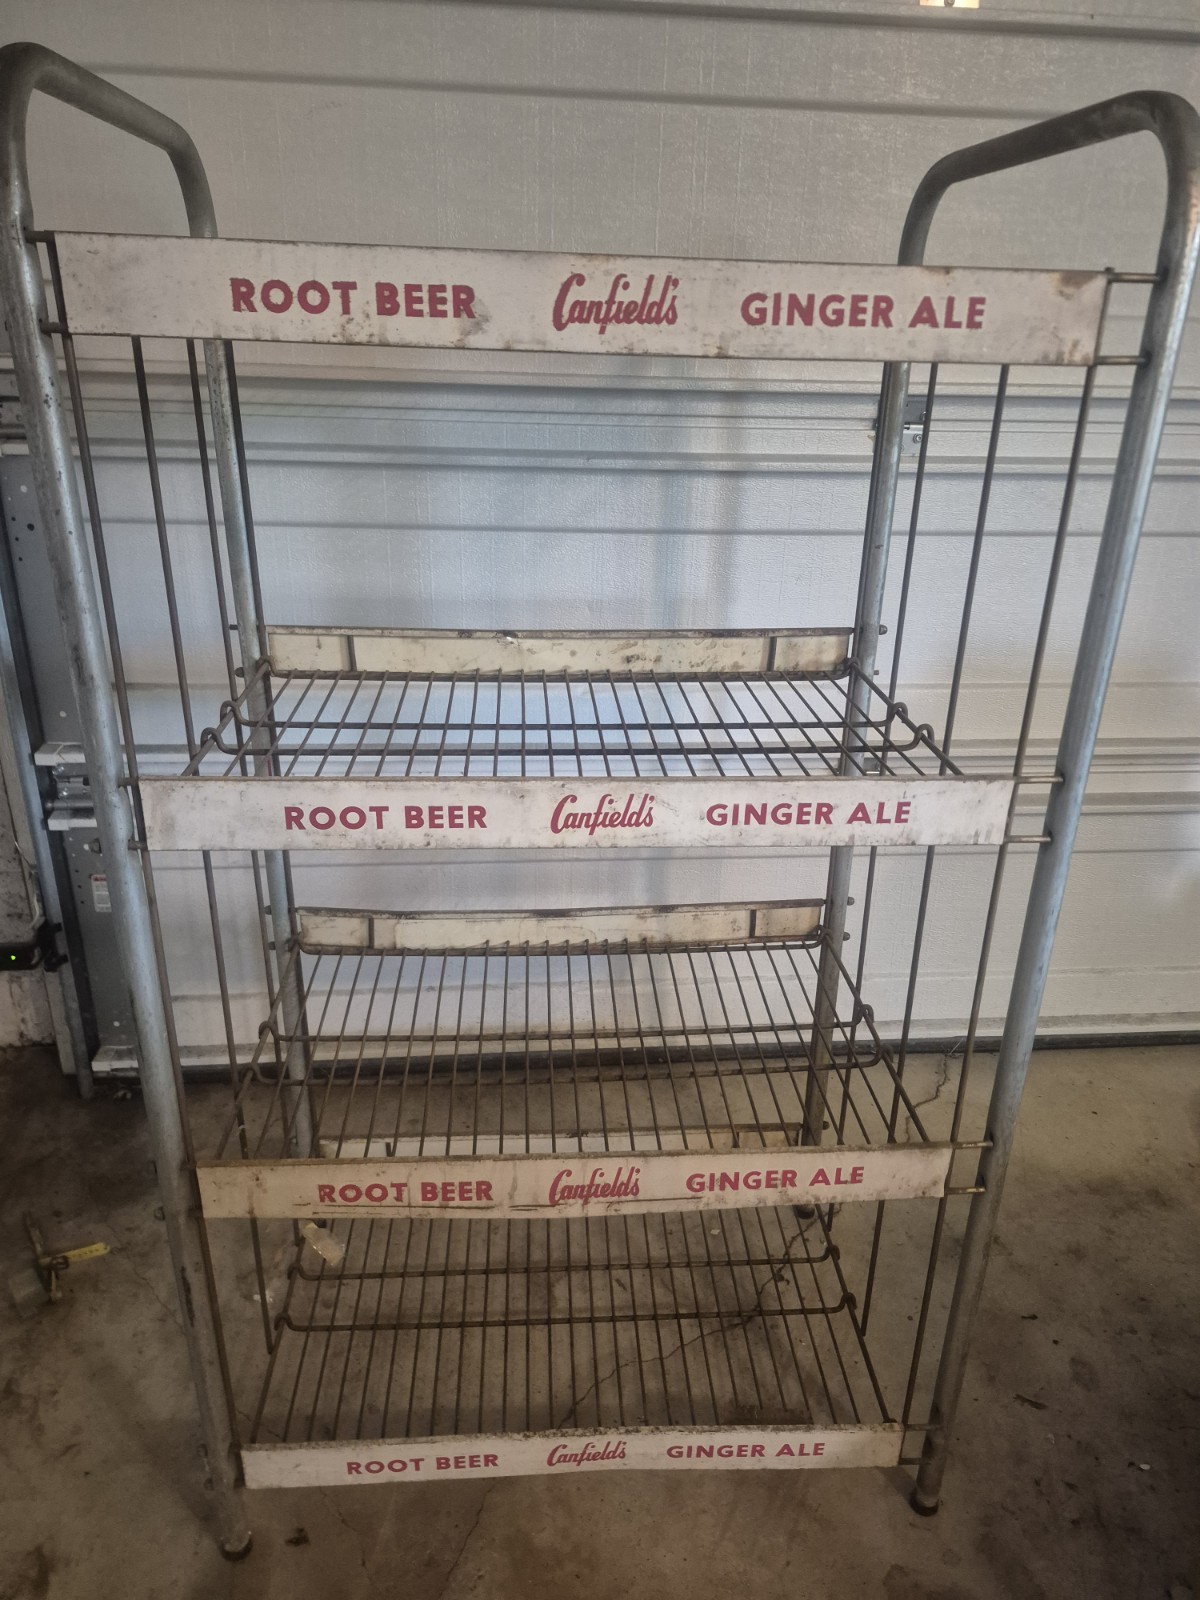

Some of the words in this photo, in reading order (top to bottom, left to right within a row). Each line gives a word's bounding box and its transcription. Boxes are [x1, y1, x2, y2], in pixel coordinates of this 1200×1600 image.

[231, 278, 357, 315] ROOT
[376, 283, 474, 318] BEER
[552, 273, 679, 335] Canfield's
[741, 293, 893, 328] GINGER
[909, 296, 985, 329] ALE
[284, 805, 389, 830] ROOT
[404, 805, 487, 829] BEER
[549, 794, 655, 836] Canfield's
[706, 803, 833, 827] GINGER
[847, 801, 911, 825] ALE
[318, 1183, 407, 1204] ROOT
[420, 1181, 493, 1202] BEER
[548, 1167, 641, 1207] Canfield's
[686, 1169, 798, 1194] GINGER
[809, 1167, 864, 1186] ALE
[546, 1441, 627, 1467] Canfield's
[667, 1443, 765, 1458] GINGER
[776, 1442, 825, 1457] ALE
[347, 1458, 425, 1475] ROOT
[435, 1454, 498, 1470] BEER
